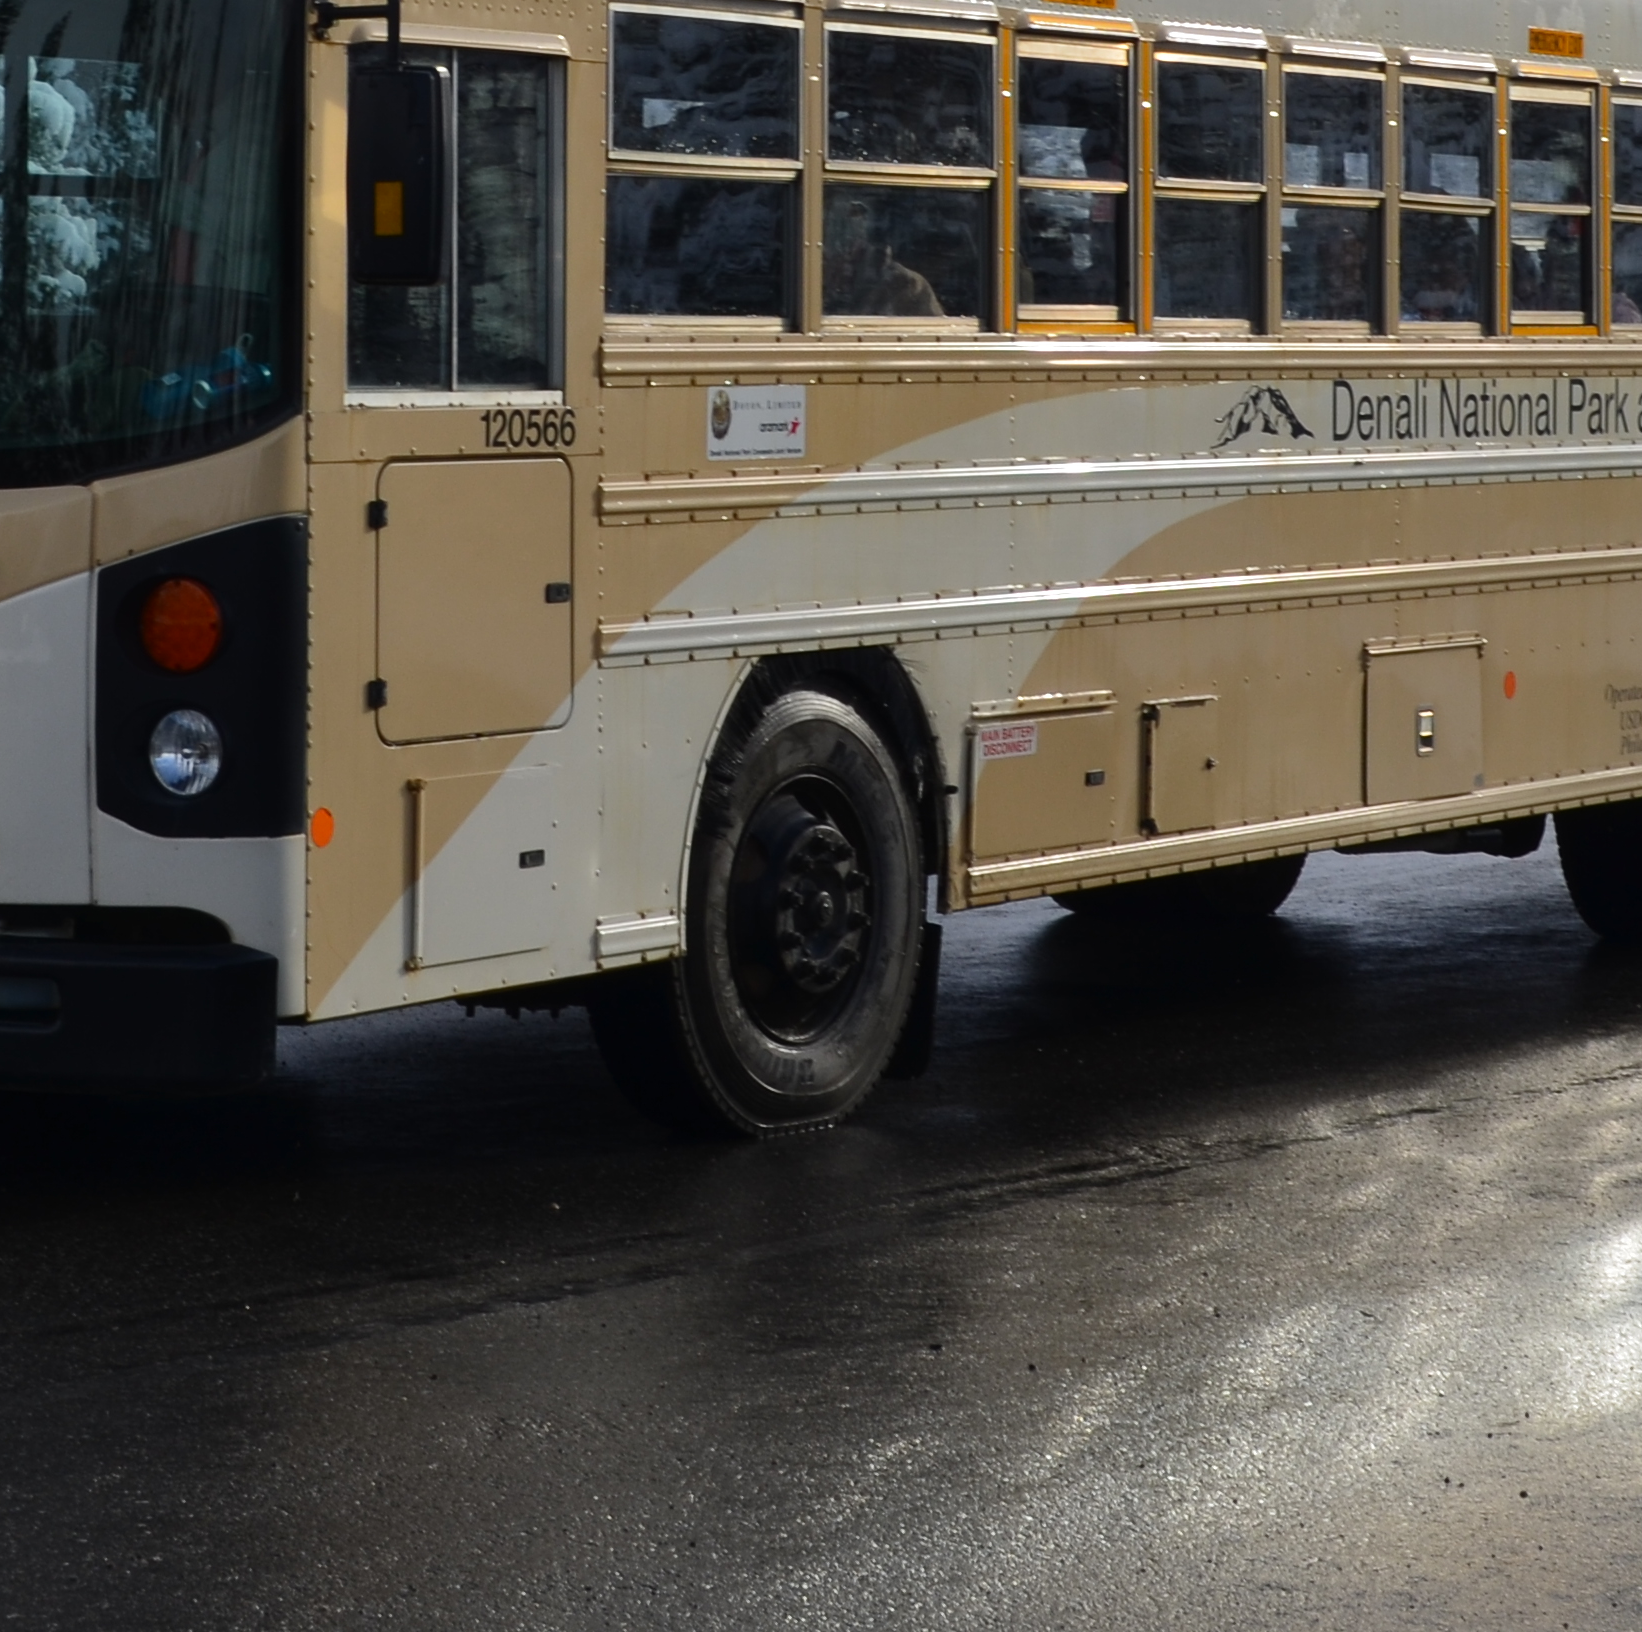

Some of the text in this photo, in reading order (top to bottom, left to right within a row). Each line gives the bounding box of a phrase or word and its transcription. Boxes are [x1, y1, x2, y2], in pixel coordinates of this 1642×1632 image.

[1332, 378, 1428, 442] Denali
[1439, 377, 1558, 439] National
[1568, 377, 1630, 435] Park
[479, 408, 577, 449] 120566
[981, 726, 1034, 742] MAIN BATTERY
[984, 740, 1032, 756] DISCONNECT
